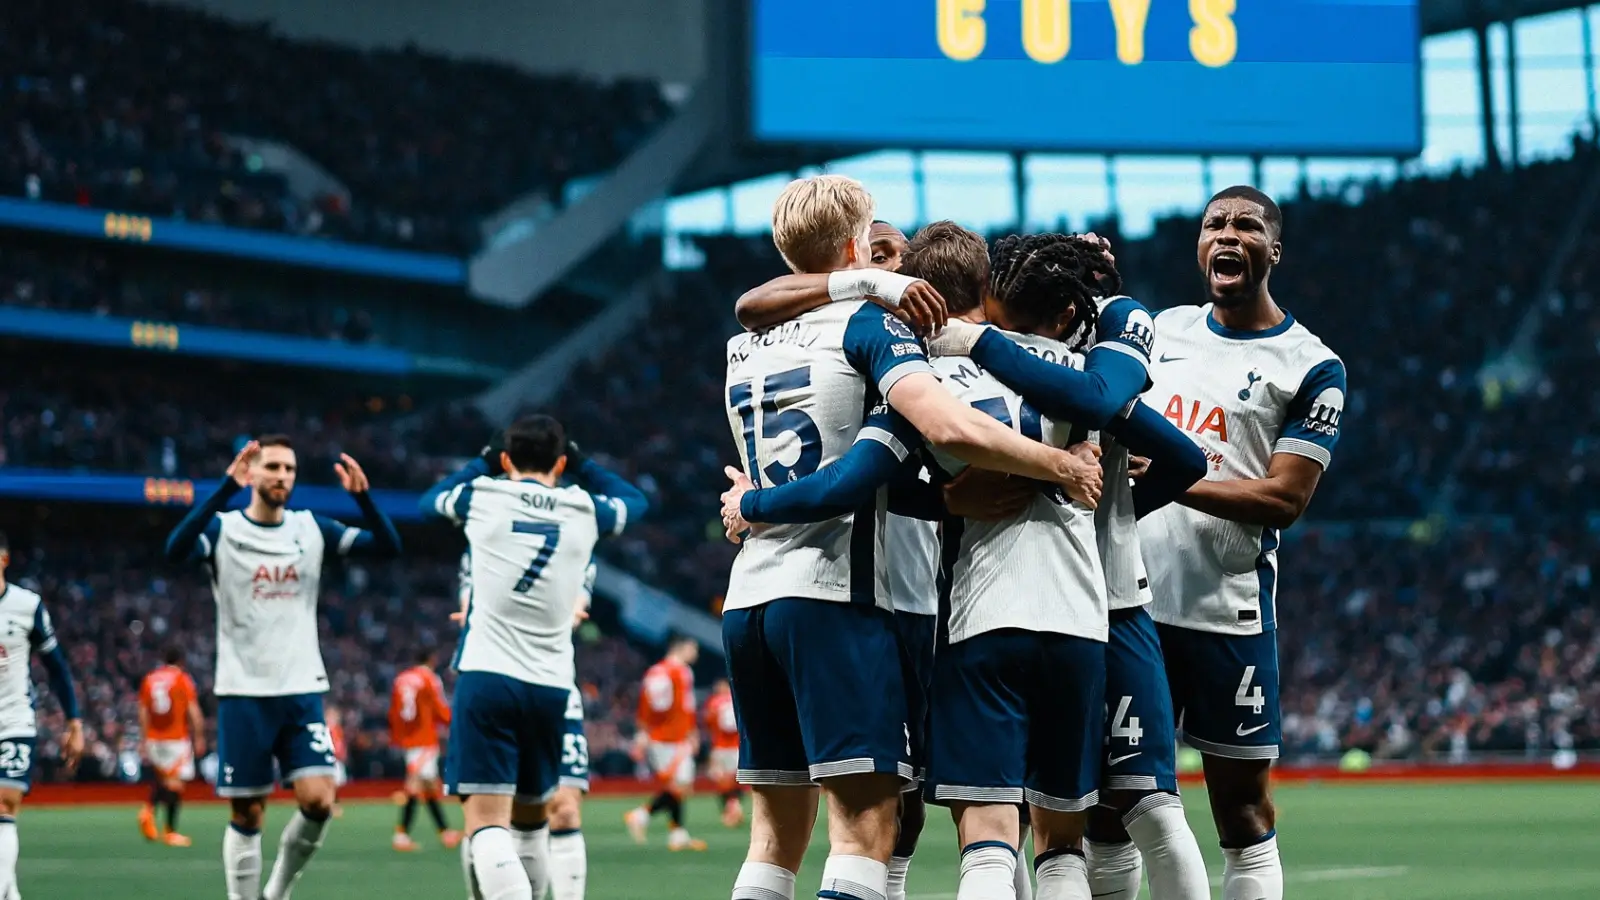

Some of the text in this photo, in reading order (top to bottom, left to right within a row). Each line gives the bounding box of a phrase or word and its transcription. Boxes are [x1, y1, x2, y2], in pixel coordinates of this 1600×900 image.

[729, 365, 823, 488] 15
[1163, 394, 1228, 443] AIA
[520, 492, 557, 511] SON
[251, 564, 300, 582] AIA
[512, 520, 560, 592] 7
[1235, 665, 1265, 714] 4
